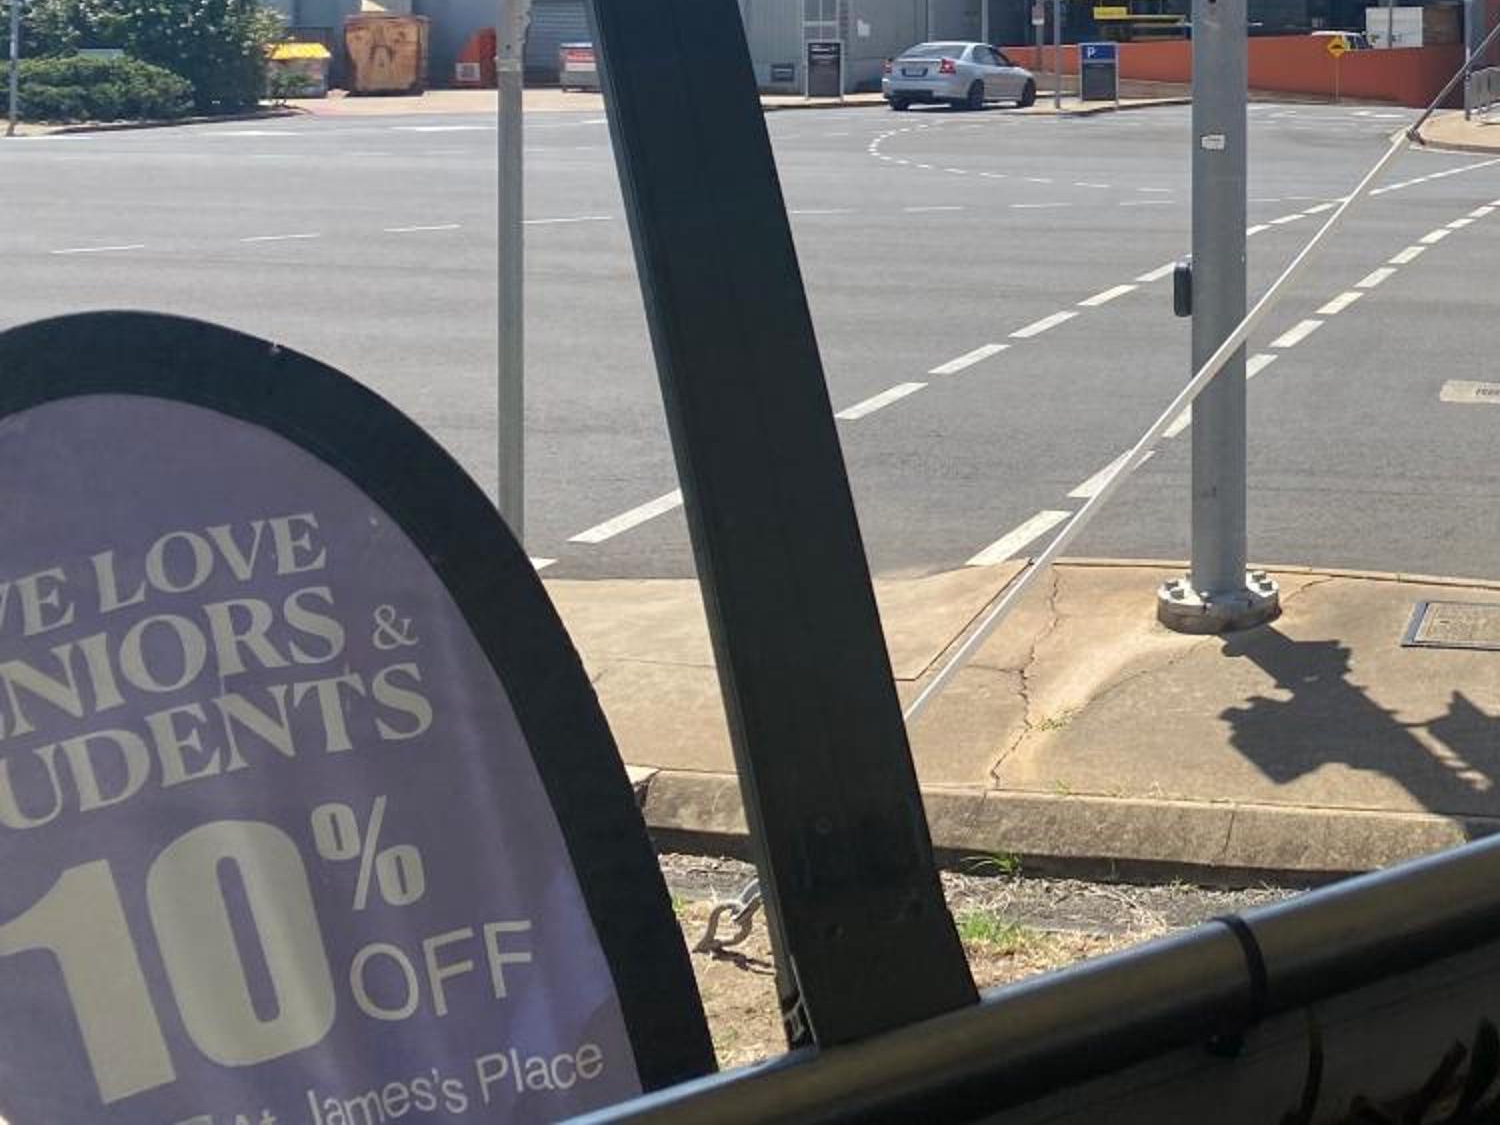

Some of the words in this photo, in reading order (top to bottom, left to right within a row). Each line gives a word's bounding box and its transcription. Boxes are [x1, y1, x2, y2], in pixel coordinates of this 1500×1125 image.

[91, 512, 326, 613] LOVE
[0, 586, 345, 741] NIORS
[372, 605, 419, 650] &
[349, 920, 533, 1022] OFF
[307, 1068, 469, 1125] James's
[475, 1042, 603, 1104] Place
